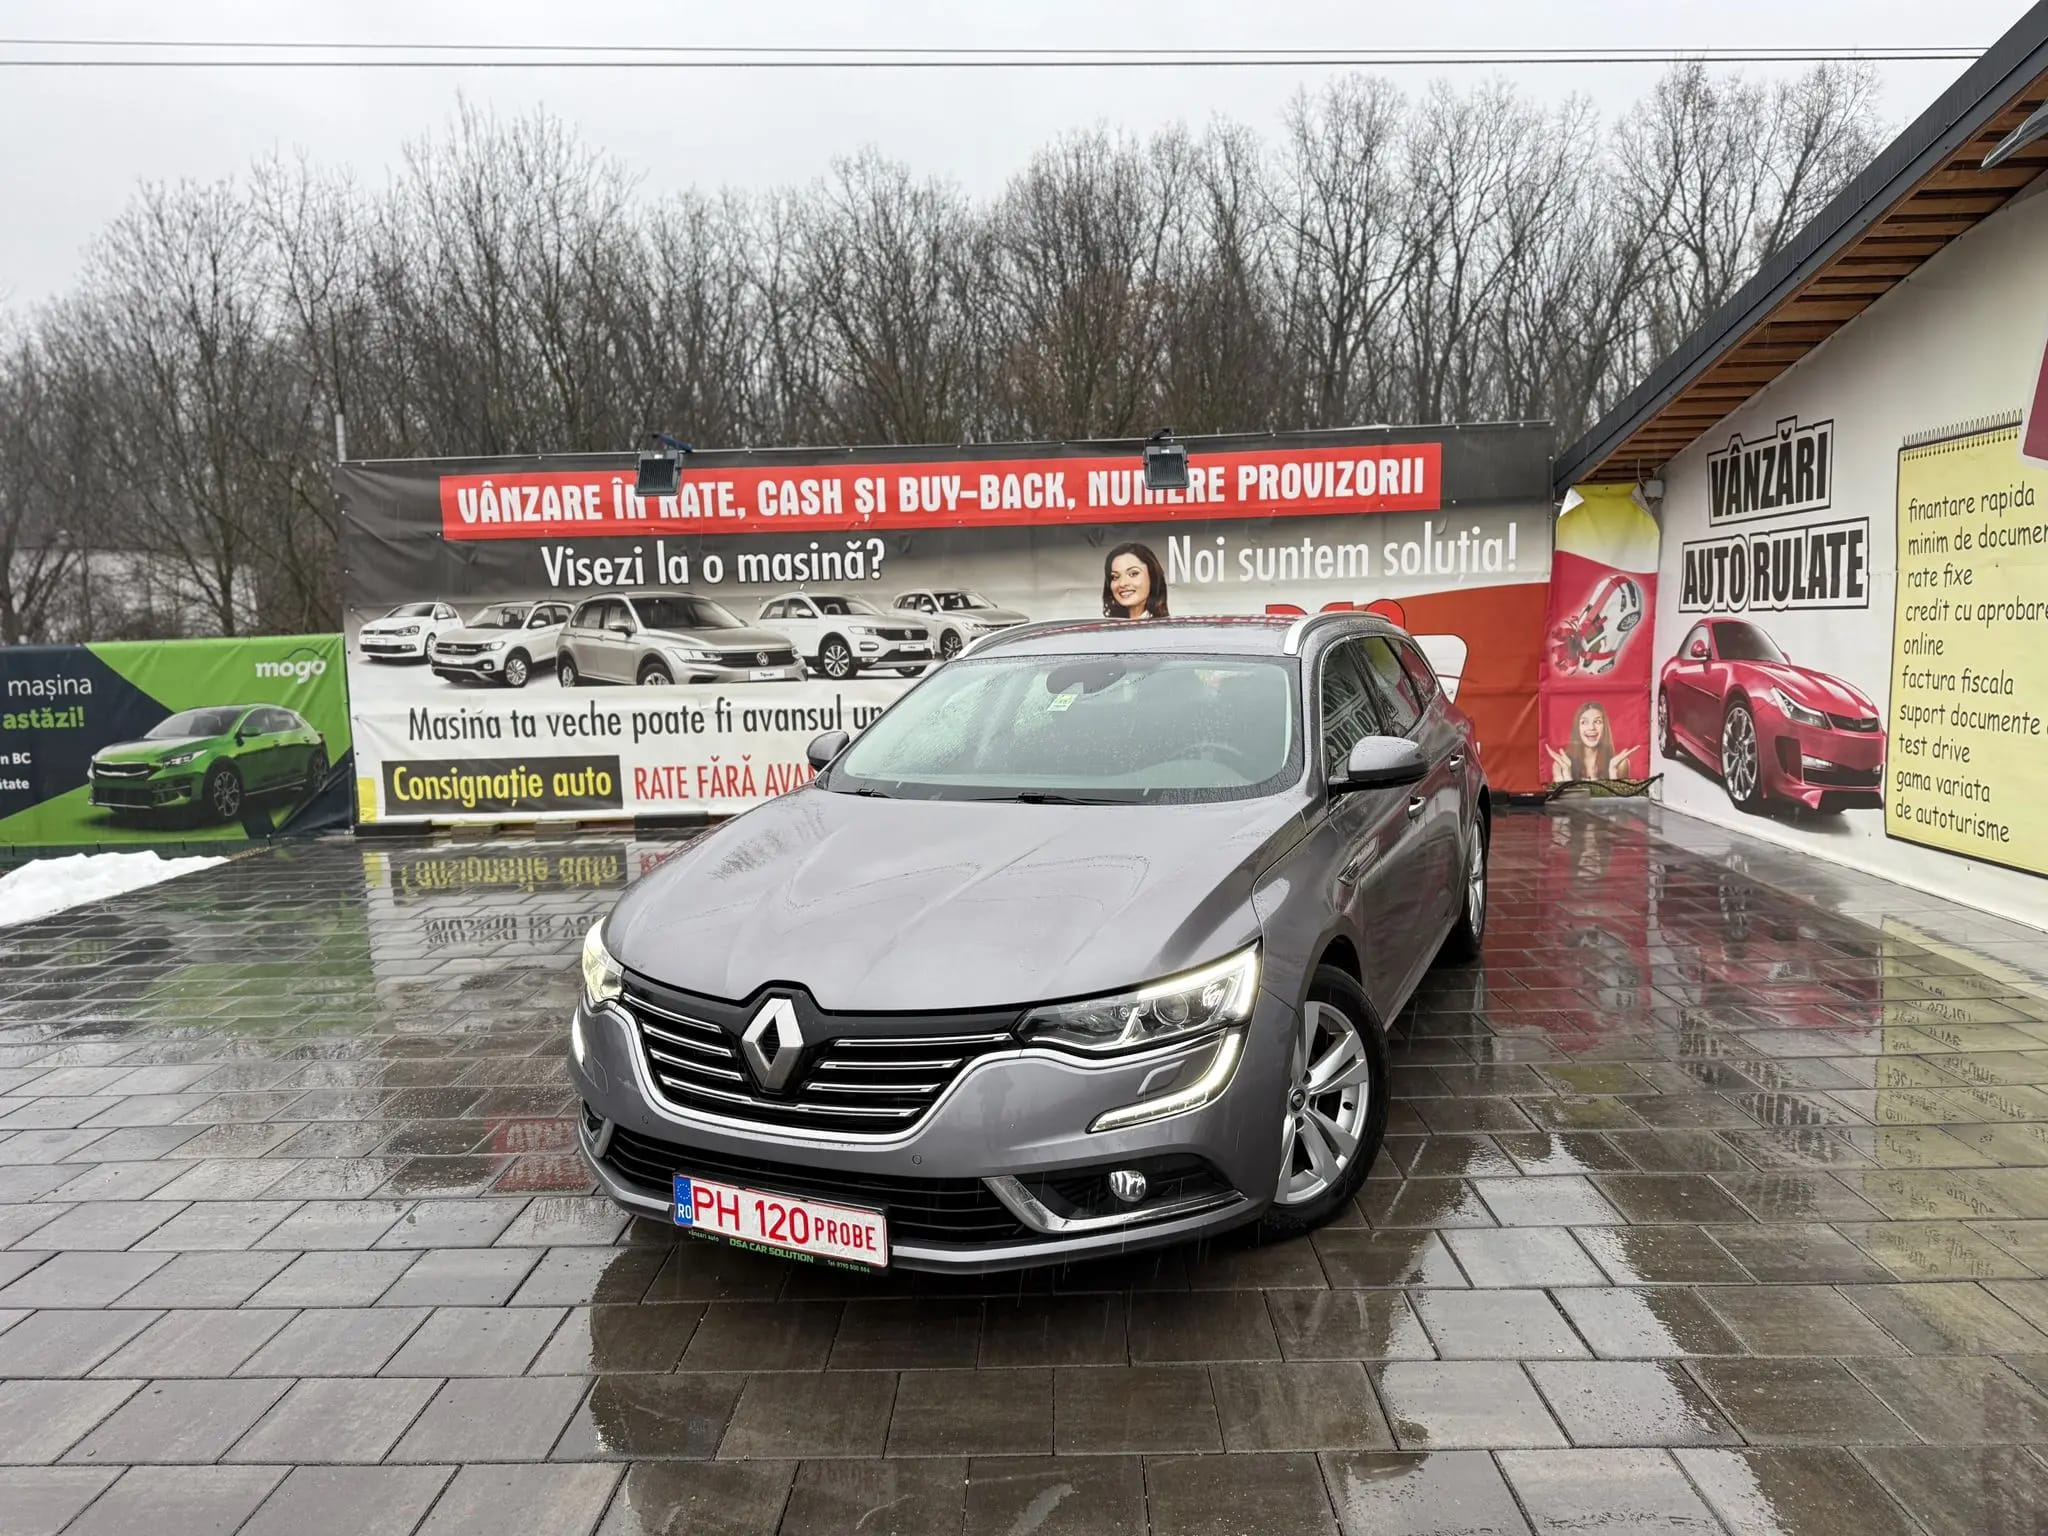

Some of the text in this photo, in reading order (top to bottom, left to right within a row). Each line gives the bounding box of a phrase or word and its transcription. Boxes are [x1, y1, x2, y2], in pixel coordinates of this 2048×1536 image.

[1711, 427, 1829, 518] VÂNZĂRI
[457, 480, 603, 524] VÂNZARE
[611, 476, 647, 520] ÎN
[658, 481, 747, 520] RATE,
[757, 478, 843, 517] CASH
[854, 476, 887, 523] ȘI
[898, 471, 1076, 512] BUY-BACK,
[1238, 457, 1424, 500] PROVIZORII
[1908, 480, 2035, 523] finantare rapida
[1168, 521, 1517, 584] Noi suntem soluția!
[1908, 531, 1949, 556] minim
[1954, 526, 1973, 551] de
[541, 545, 645, 587] Visezi
[656, 539, 690, 585] la
[702, 553, 724, 585] o
[1683, 529, 1863, 606] AUTO RULATE
[1907, 562, 1973, 588] rate fixe
[1906, 597, 1950, 622] credit
[1954, 602, 1972, 621] cu
[1903, 632, 1944, 656] online
[7, 673, 92, 701] mașina
[255, 659, 327, 685] mogo
[1902, 665, 2014, 695] factura fiscala
[2, 706, 85, 730] astăzi!
[409, 706, 502, 741] Masina
[510, 709, 537, 738] ta
[546, 699, 621, 737] veche
[632, 705, 705, 744] poate
[715, 697, 732, 733] fi
[743, 694, 842, 733] avansul
[1900, 703, 1945, 729] suport
[1951, 702, 2040, 735] documente
[12, 752, 32, 765] BC
[1899, 733, 1970, 764] test drive
[393, 765, 612, 808] Consignație auto
[634, 766, 689, 800] RATE
[697, 754, 757, 799] FĂRĂ
[1896, 770, 1990, 803] gama variata
[1896, 797, 2010, 843] de autoturisme
[677, 1202, 692, 1220] RO
[692, 1185, 877, 1251] PH 120 PROBE
[749, 1241, 768, 1255] CAR
[768, 1246, 814, 1264] SOLUTION
